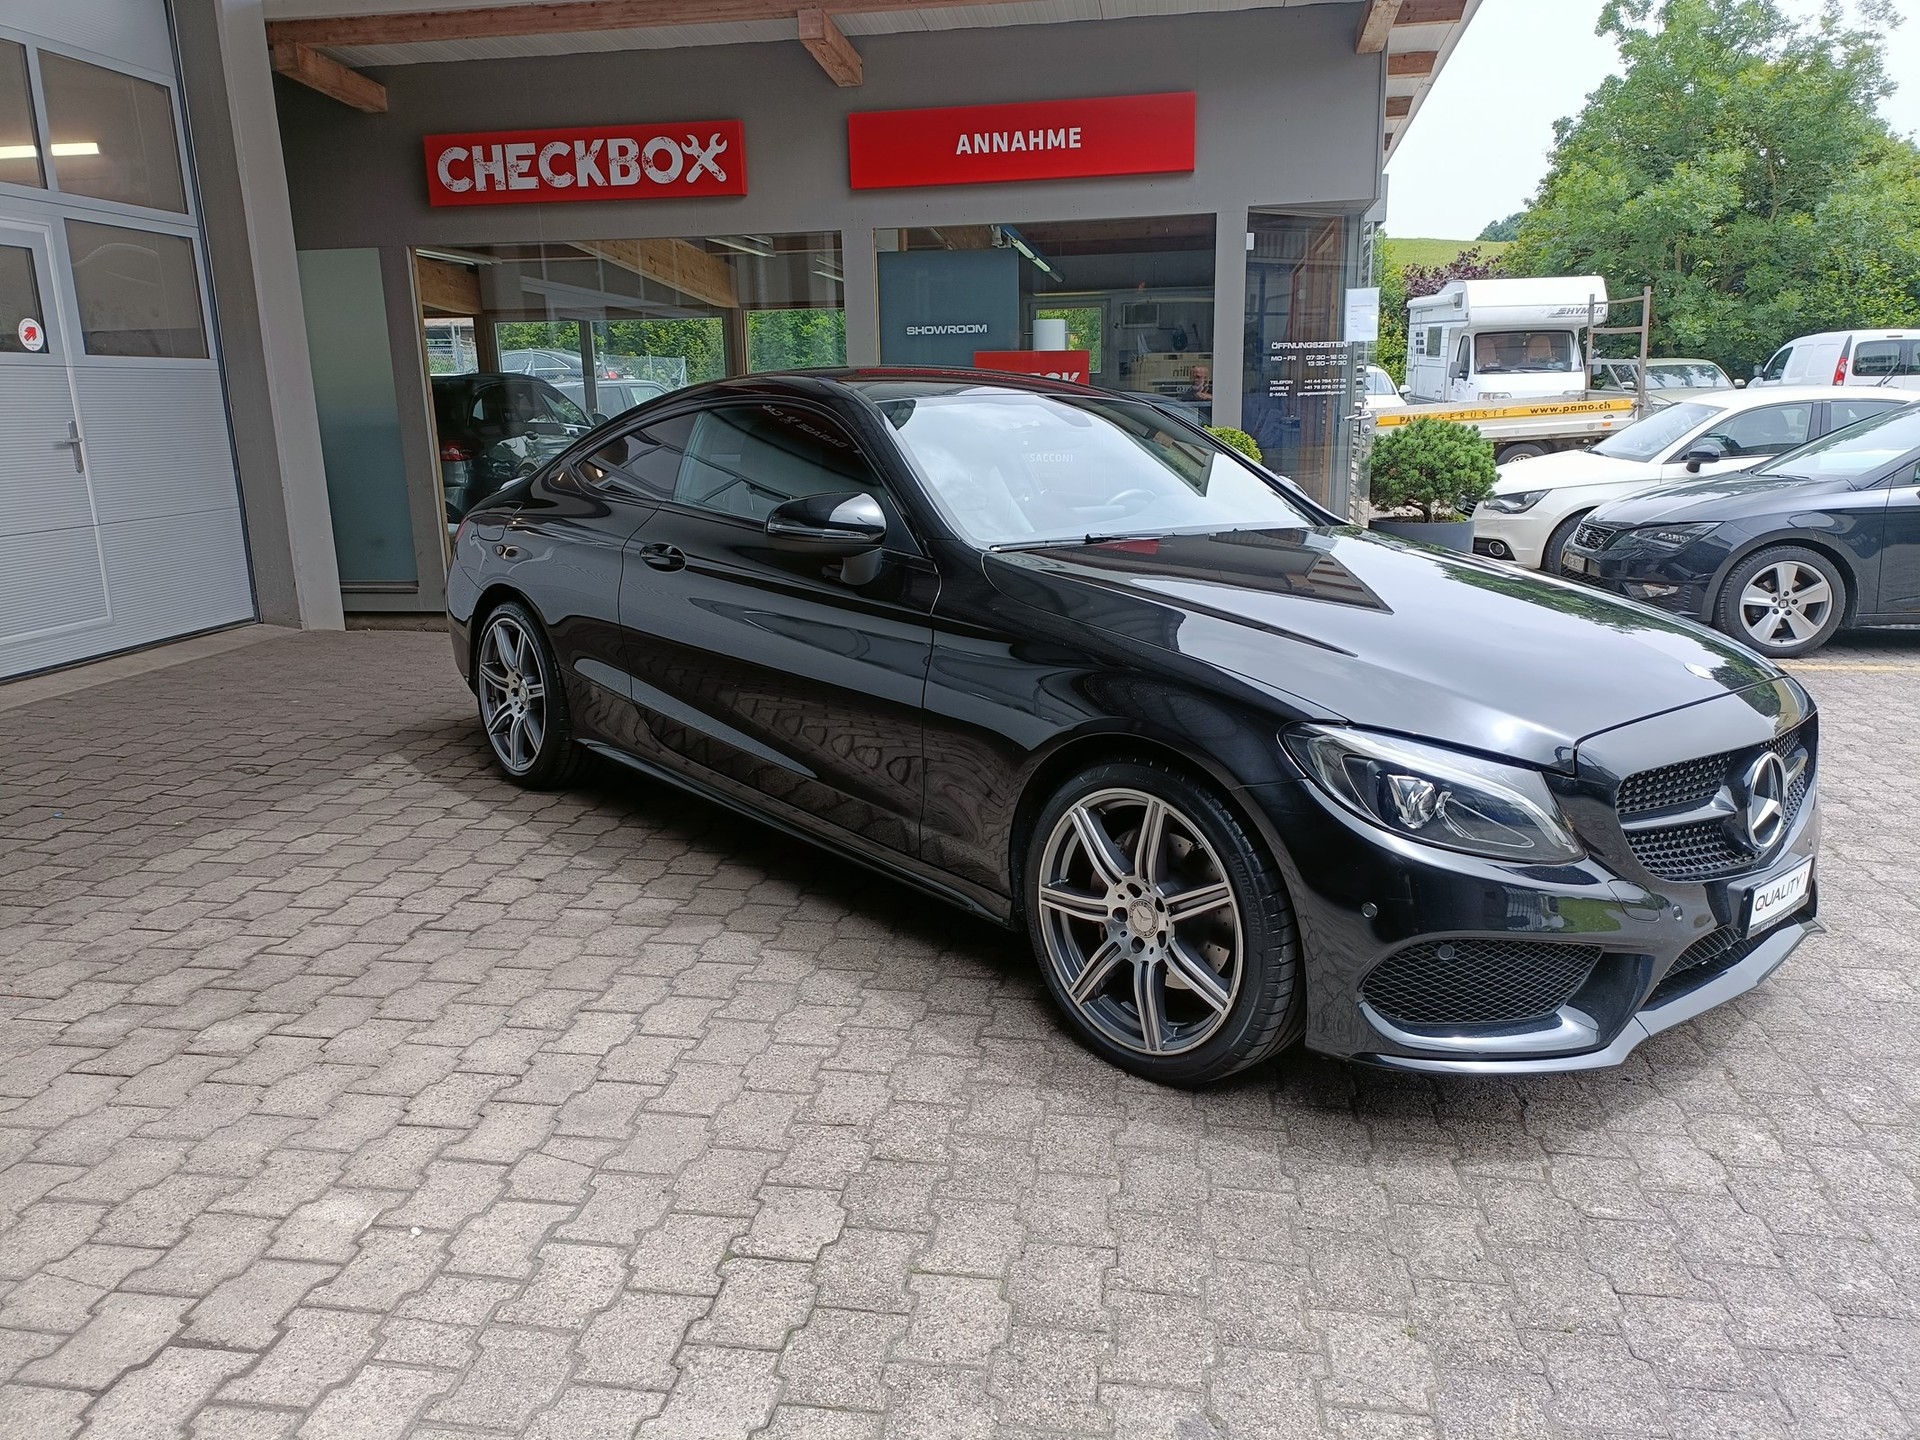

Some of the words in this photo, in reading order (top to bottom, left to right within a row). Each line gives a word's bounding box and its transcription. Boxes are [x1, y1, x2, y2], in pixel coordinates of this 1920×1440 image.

[956, 127, 1082, 155] ANNAHME
[906, 324, 988, 335] SHOWROOM
[1271, 341, 1348, 349] ÖFFNUNGSZEITEN
[1529, 402, 1611, 414] www.pamo.ch
[1029, 453, 1073, 462] SACCONI
